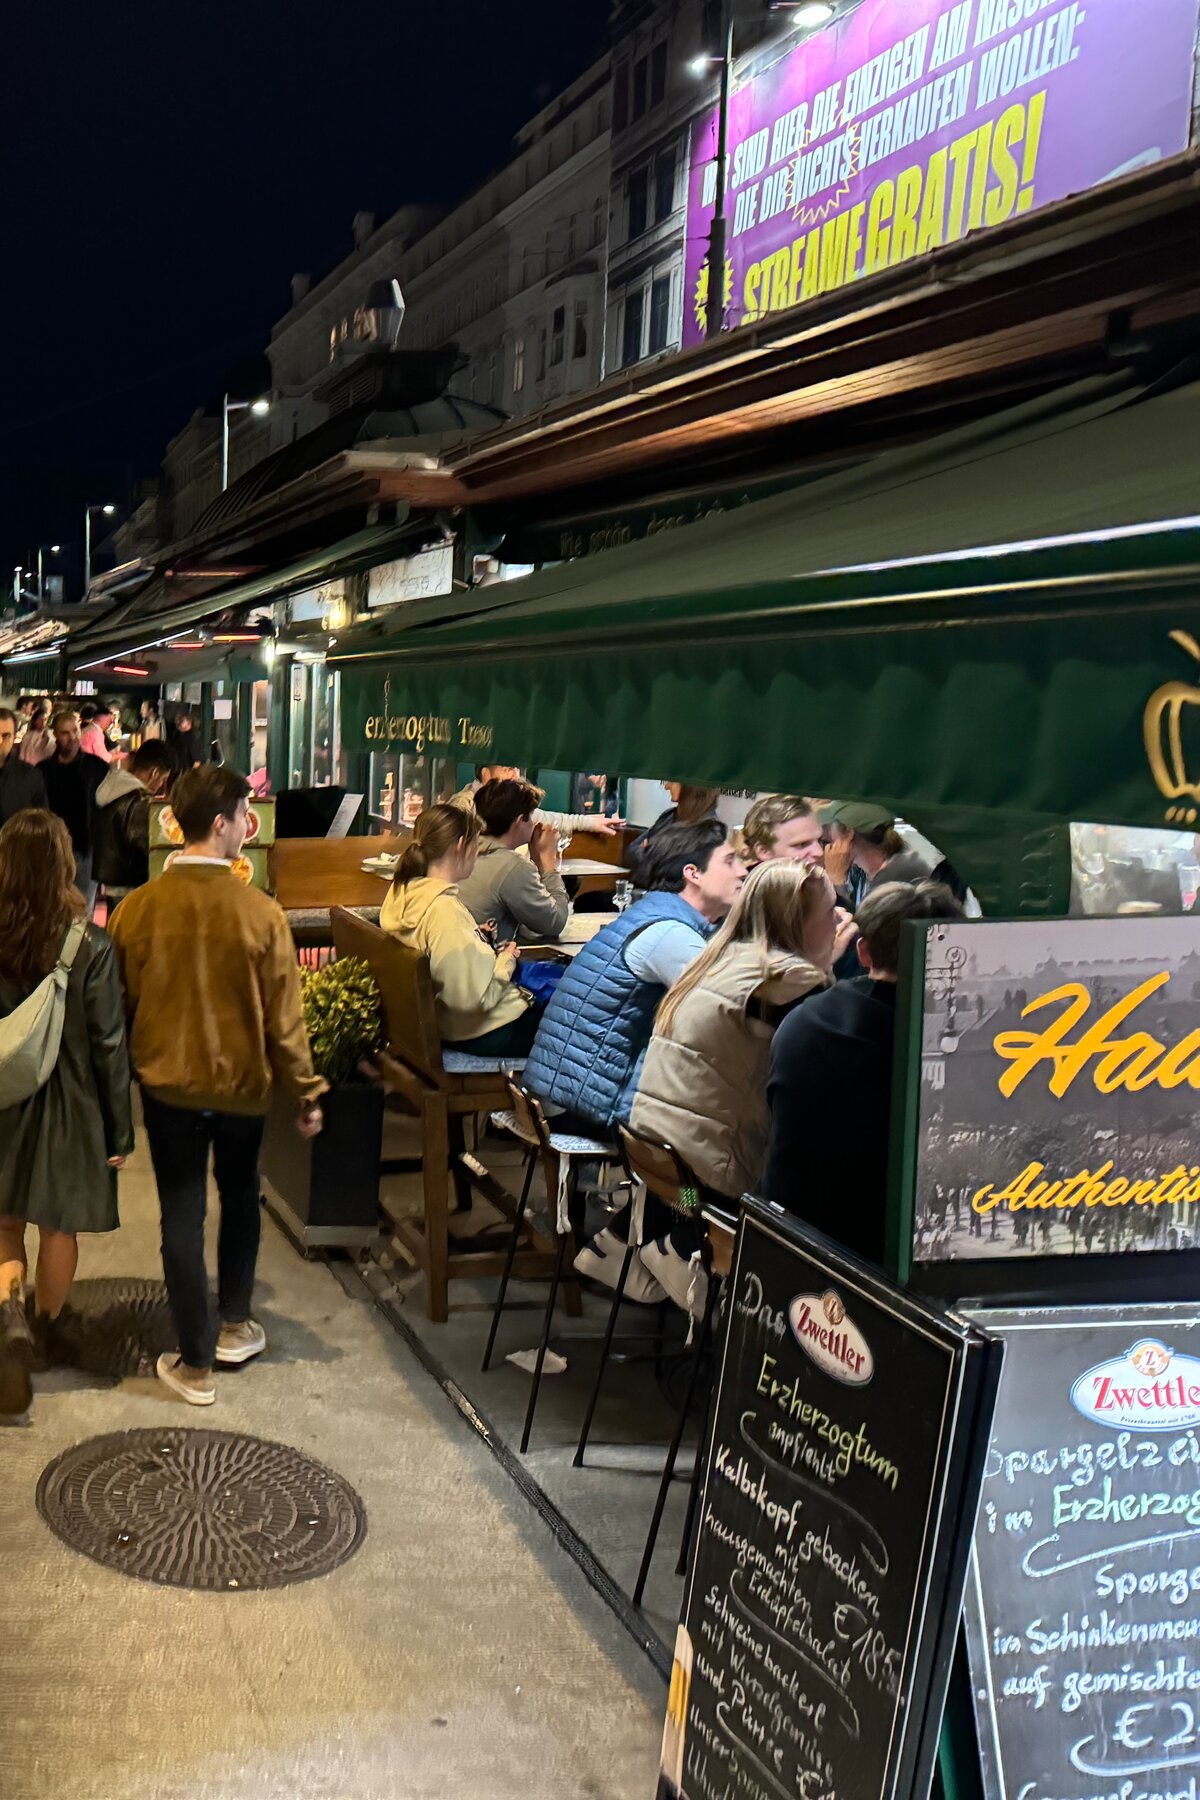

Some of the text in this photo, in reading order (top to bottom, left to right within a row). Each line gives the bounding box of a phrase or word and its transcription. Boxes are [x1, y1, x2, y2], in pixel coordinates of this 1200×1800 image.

[732, 128, 770, 190] SIND
[770, 101, 809, 168] HIER
[808, 80, 842, 144] DIE
[842, 24, 930, 124] EINZIGEN
[928, 0, 973, 73] AM
[732, 182, 760, 238] DIE
[759, 166, 790, 224] DIR
[787, 127, 853, 208] NICHTS
[857, 60, 974, 171] VERKAUFEN
[741, 90, 1047, 327] STREAME GRATIS!
[797, 1302, 866, 1375] Zwettler
[756, 1352, 900, 1492] Erzherzogtum
[714, 1443, 803, 1543] Kalbskopf
[696, 1651, 726, 1696] und
[700, 1618, 726, 1655] mit
[1003, 1664, 1052, 1710] auf
